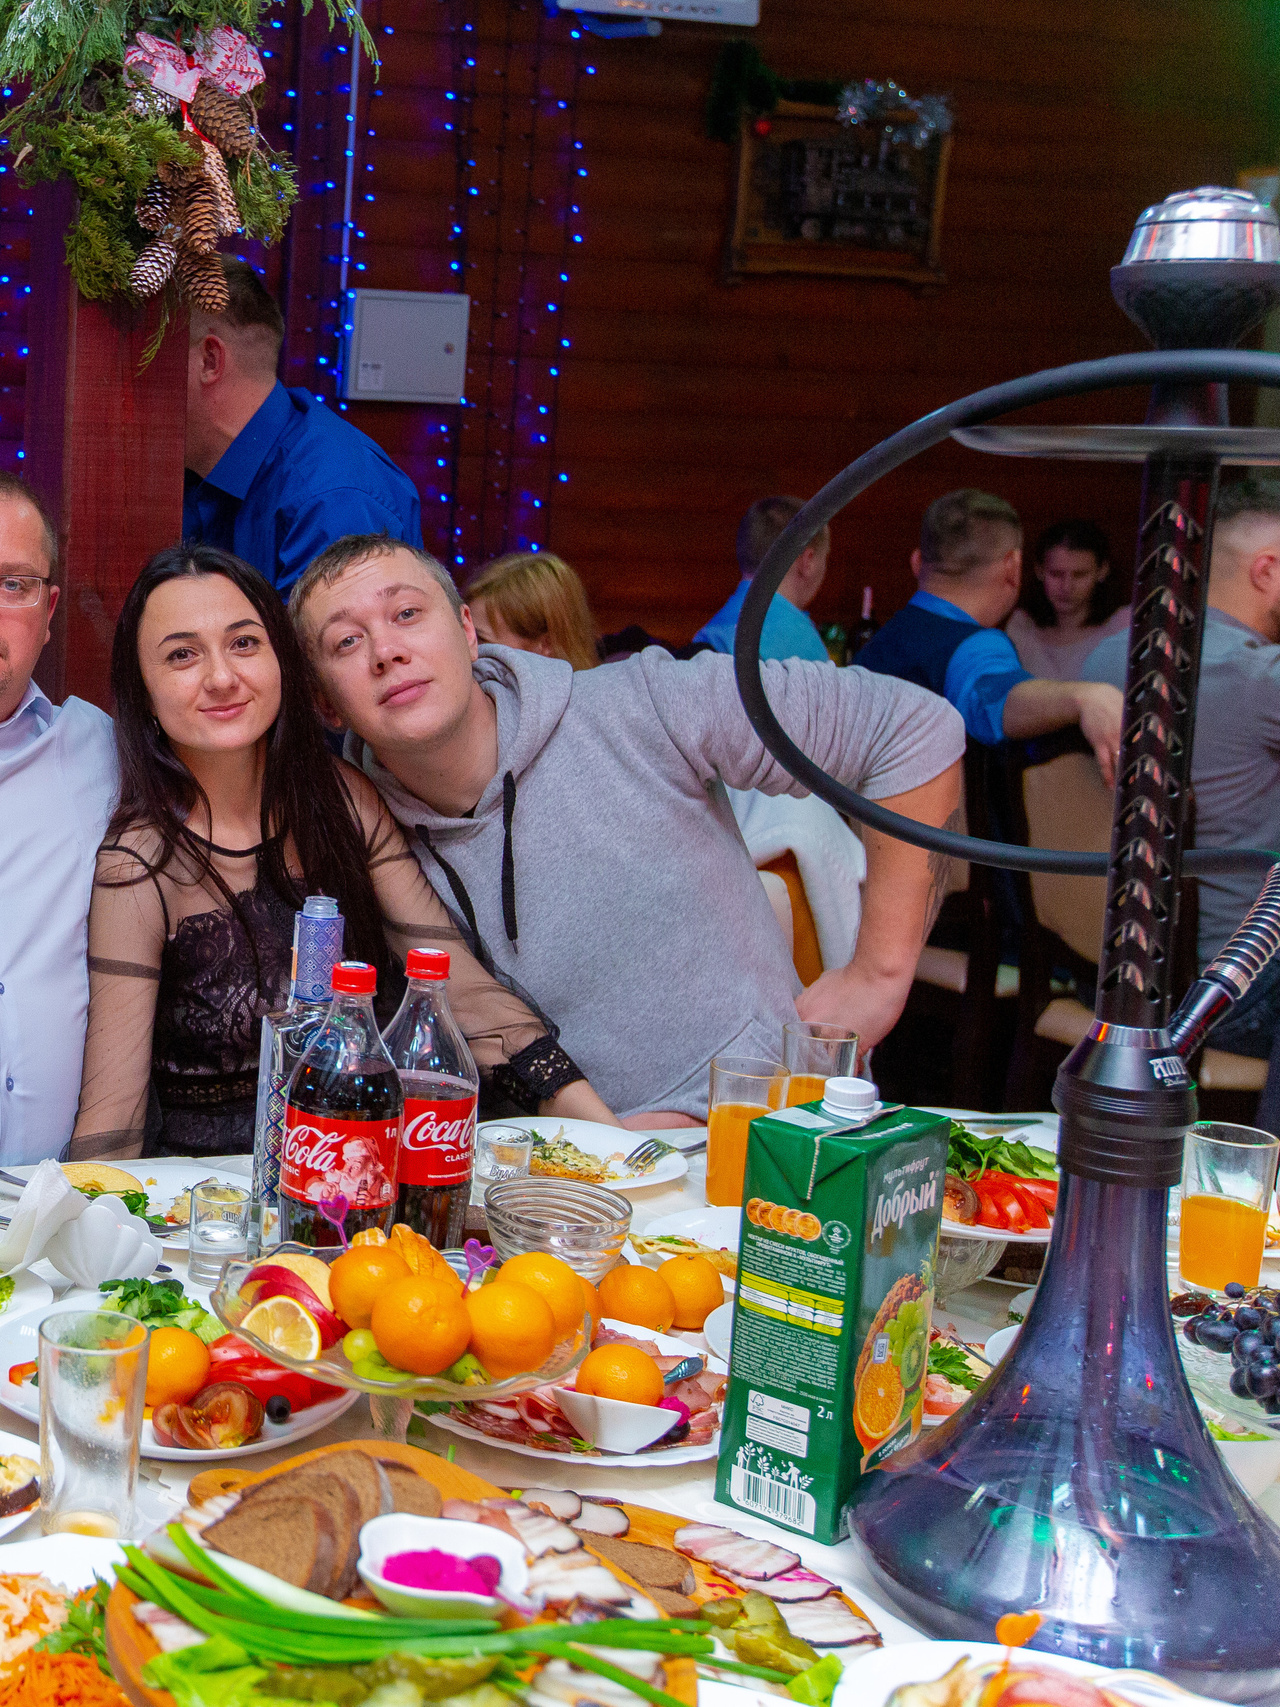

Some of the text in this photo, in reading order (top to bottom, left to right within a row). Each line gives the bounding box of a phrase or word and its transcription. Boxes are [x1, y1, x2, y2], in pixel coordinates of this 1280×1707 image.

[871, 1170, 937, 1244] Добрый
[816, 1405, 825, 1418] 2
[825, 1410, 834, 1420] л
[775, 1510, 802, 1526] 579682
